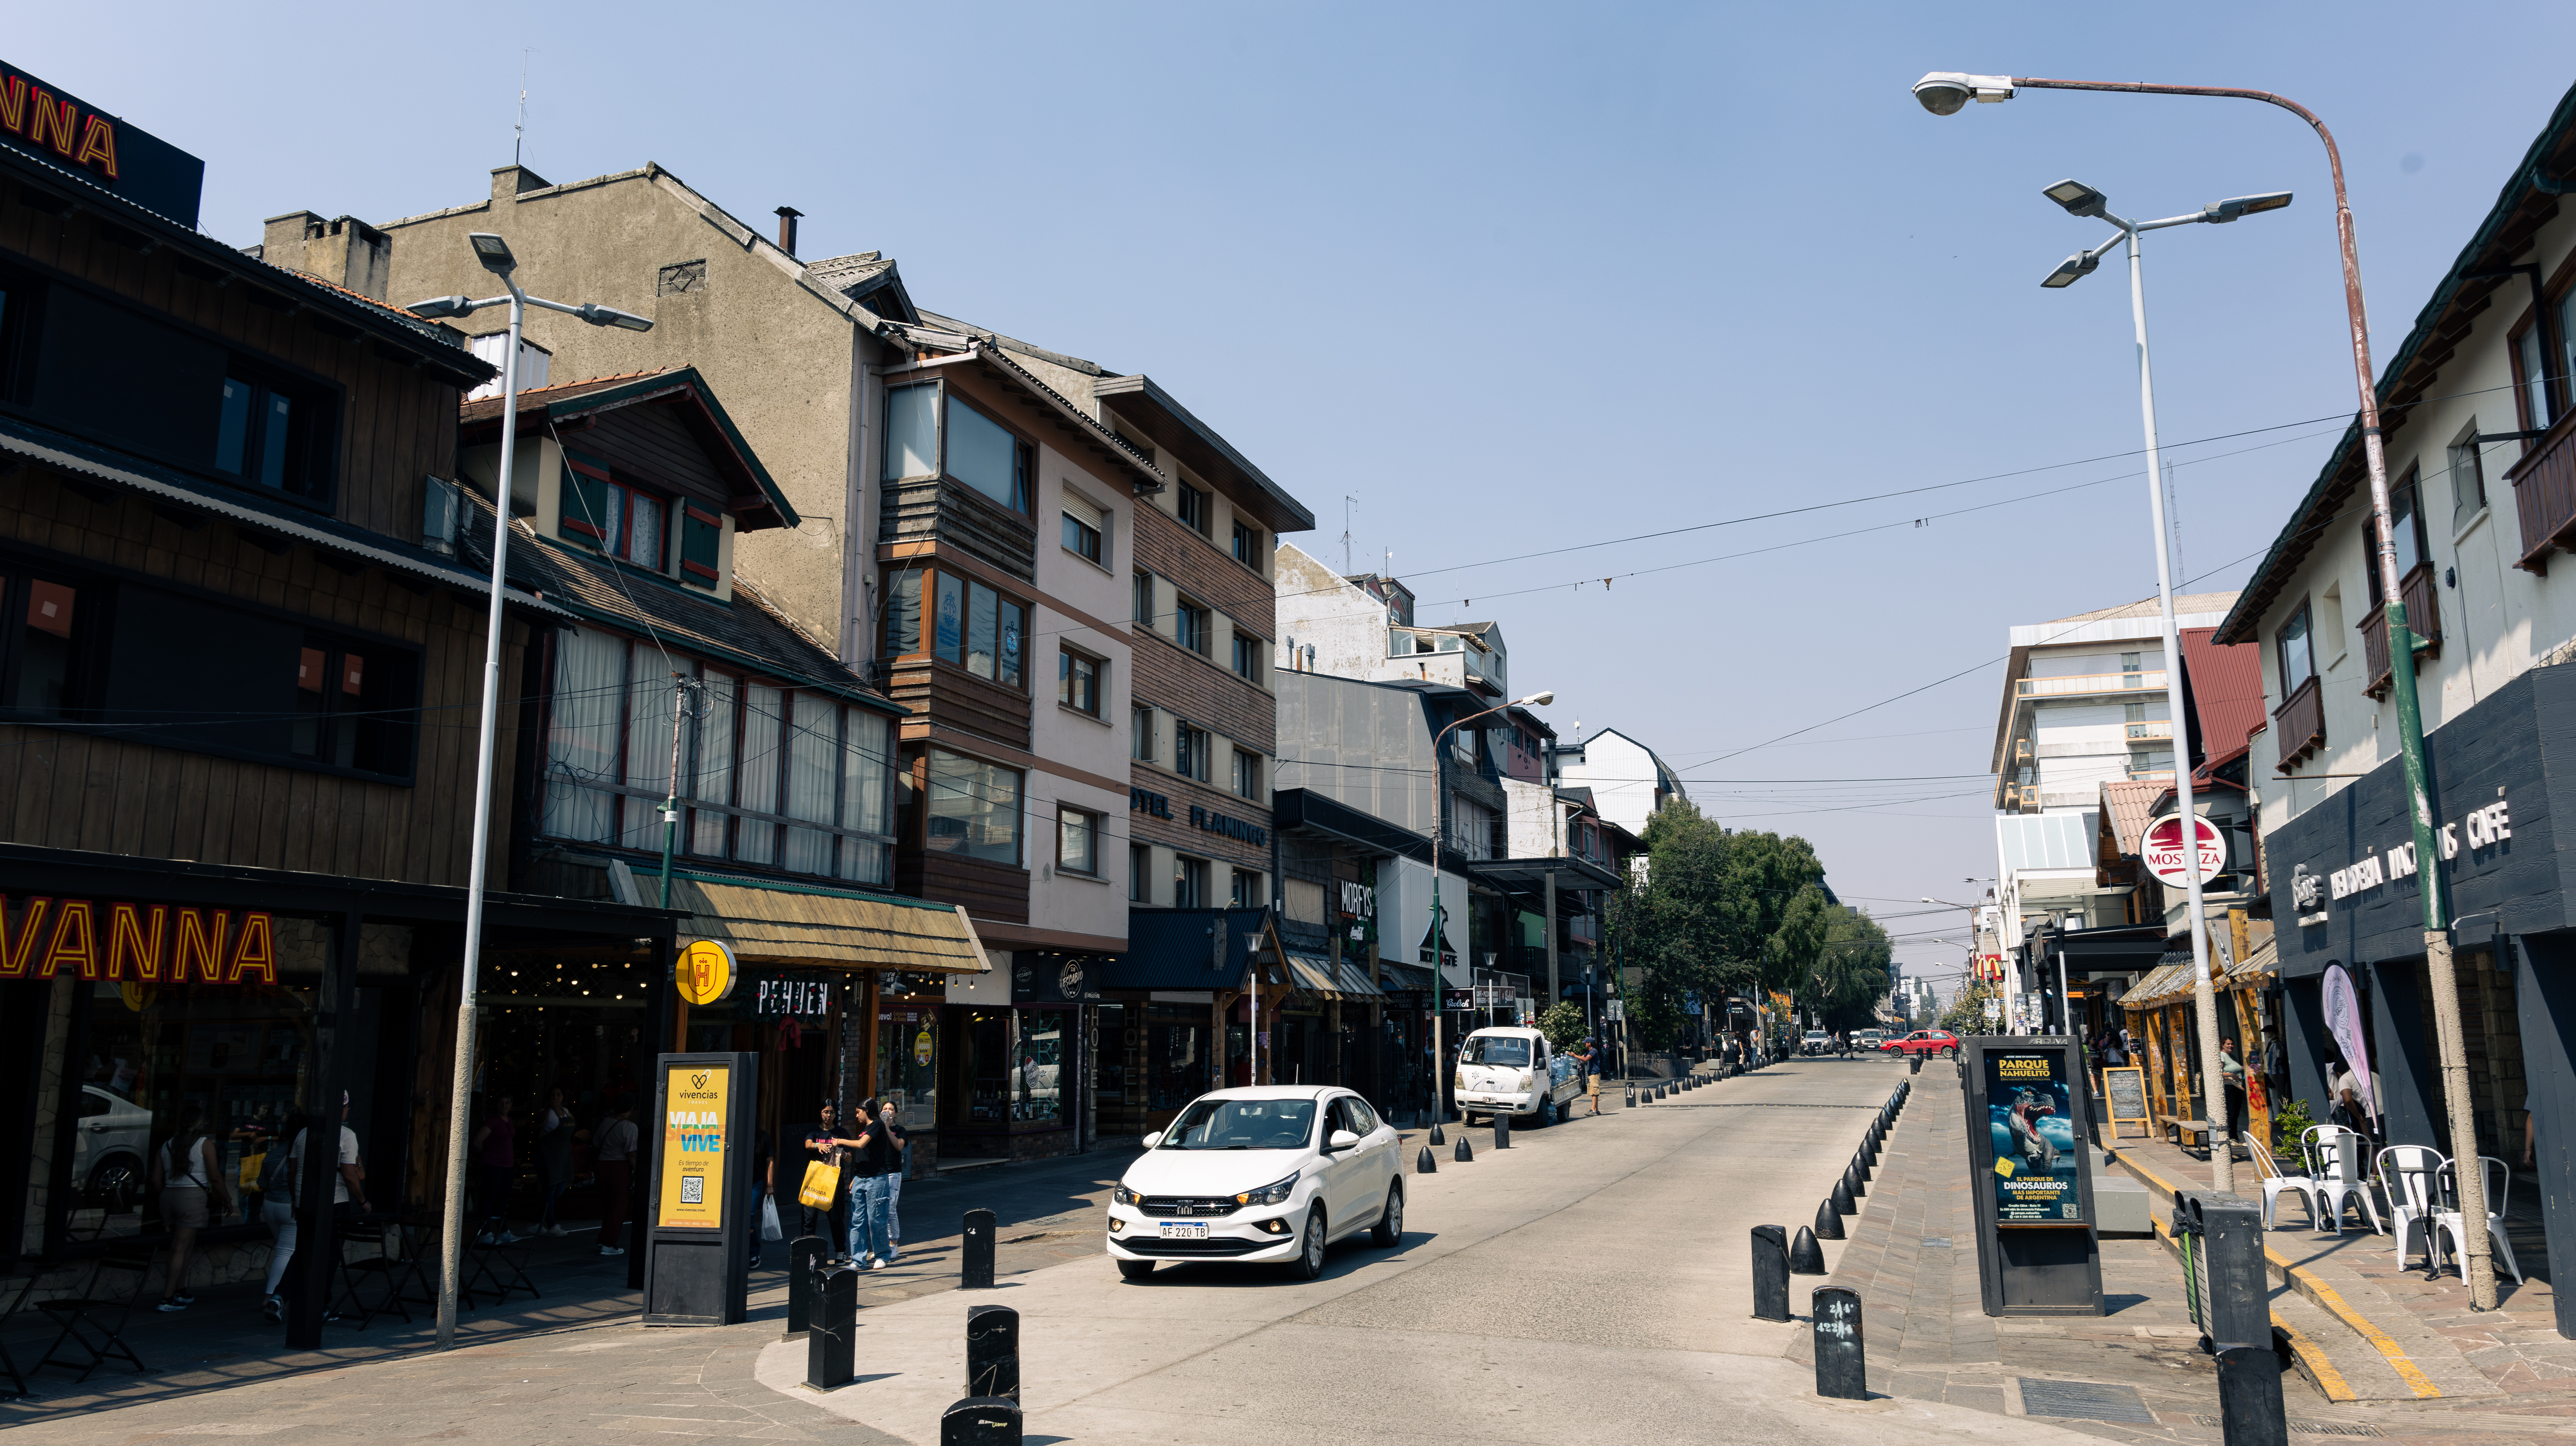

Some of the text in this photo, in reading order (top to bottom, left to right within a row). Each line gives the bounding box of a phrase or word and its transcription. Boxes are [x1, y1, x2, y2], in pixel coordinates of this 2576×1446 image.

[1130, 787, 1267, 847] OTEL FLAMINGO
[2388, 823, 2458, 880] MACNS
[2467, 786, 2511, 850] CAFÉ
[2148, 853, 2221, 865] MOSZA
[1342, 880, 1372, 920] MORFYS
[1062, 970, 1083, 987] ESCABIO
[759, 980, 828, 1015] PEHUEN
[1446, 998, 1470, 1009] Grolsch
[1124, 1009, 1138, 1105] HOTEL
[1999, 1060, 2049, 1069] PARQUE
[679, 1090, 718, 1099] vivencias
[669, 1111, 718, 1130] VIAJA
[681, 1134, 721, 1152] VIVE
[1999, 1163, 2012, 1173] 24.5
[1163, 1227, 1205, 1237] AF 220 TB
